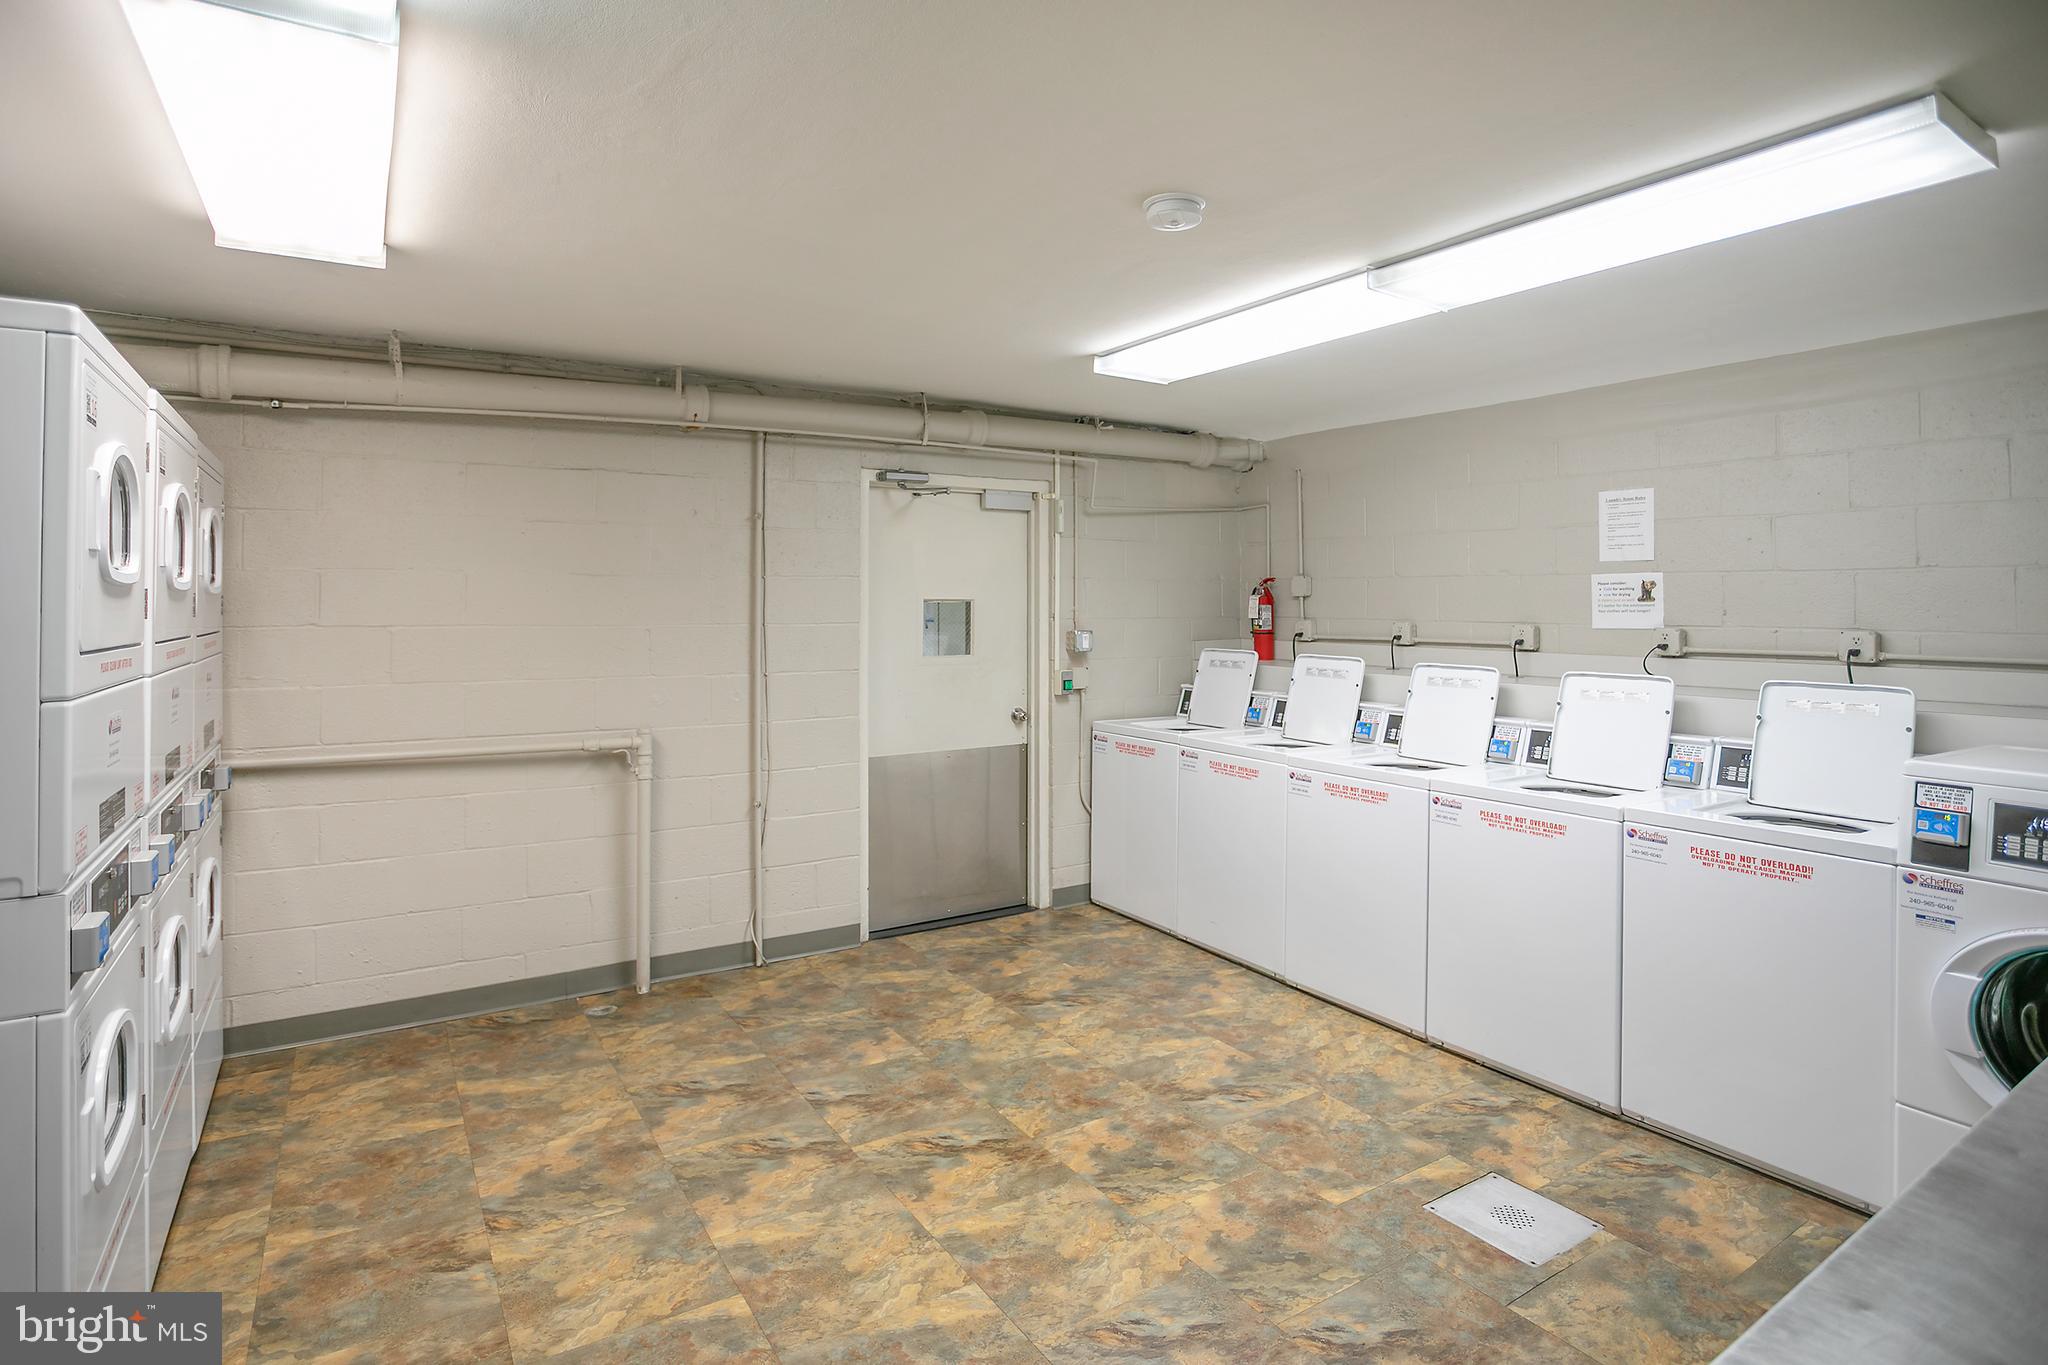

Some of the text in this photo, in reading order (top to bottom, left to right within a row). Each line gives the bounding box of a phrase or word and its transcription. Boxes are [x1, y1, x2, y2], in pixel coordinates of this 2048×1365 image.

[1480, 810, 1501, 819] PLEASE
[1529, 819, 1567, 831] OVERLOAD!!
[1481, 817, 1512, 826] OVERLOADING
[1542, 827, 1565, 836] MACHINE
[1507, 826, 1527, 834] OPERATE
[1638, 829, 1669, 841] Scheffres
[1690, 846, 1814, 874] PLEASE DO NOT OVERLOAD!!
[1691, 854, 1735, 866] OVERLOADING
[1754, 865, 1776, 873] CAUSE
[1779, 870, 1812, 880] MACHINE
[1728, 866, 1758, 876] OPERATE
[1920, 874, 1964, 890] Scheffres
